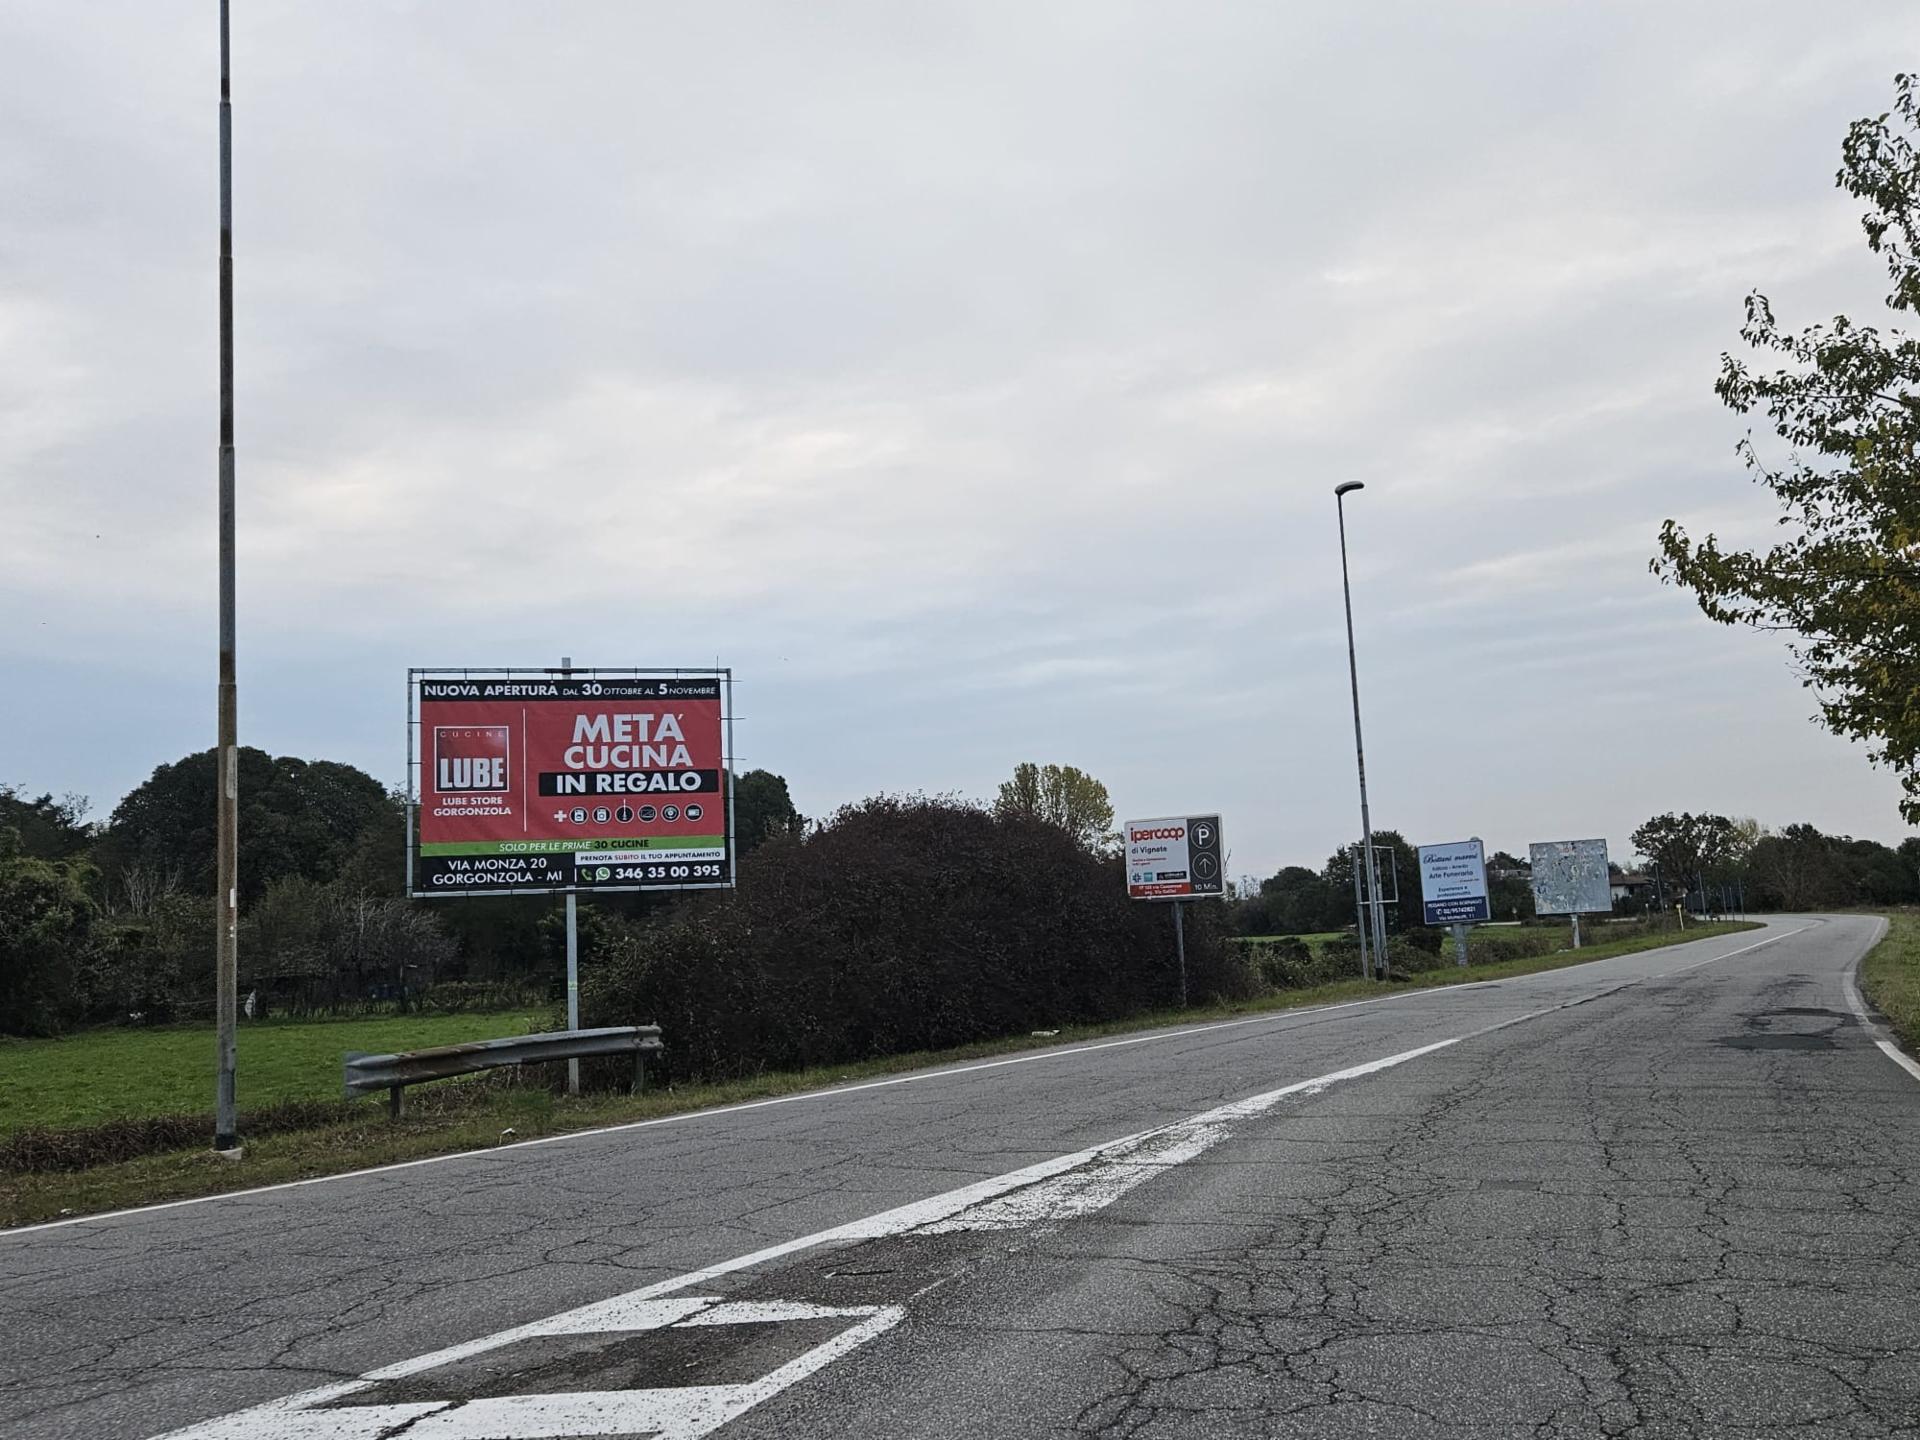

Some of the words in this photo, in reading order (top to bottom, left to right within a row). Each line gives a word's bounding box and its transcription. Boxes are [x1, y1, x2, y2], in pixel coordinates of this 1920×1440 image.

[424, 685, 480, 696] NUOVA
[484, 685, 558, 696] APERTURA
[562, 688, 580, 696] DAL
[582, 683, 602, 696] 30
[603, 687, 643, 696] OTTOBRE
[644, 687, 655, 695] AL
[658, 683, 668, 695] 5
[669, 686, 716, 695] NOVEMBRE
[440, 730, 504, 738] CUCINE
[563, 744, 694, 769] CUCINA
[440, 757, 504, 788] LUBE
[556, 774, 586, 794] IN
[596, 771, 702, 793] REGALO
[442, 797, 468, 806] LUBE
[470, 796, 503, 806] STORE
[433, 807, 512, 816] GORGONZOLA
[1130, 827, 1185, 843] ipercoop
[499, 843, 527, 852] SOLO
[529, 842, 547, 851] PER
[548, 842, 560, 851] LE
[562, 841, 592, 850] PRIME
[594, 840, 608, 849] 30
[611, 839, 650, 849] CUCINE
[1131, 846, 1139, 855] di
[1139, 845, 1168, 855] Vignate
[580, 854, 613, 862] PRENOTA
[640, 853, 648, 861] IL
[664, 851, 721, 860] APPUNTAMENTO
[447, 860, 471, 871] VIA
[474, 859, 527, 871] MONZA
[529, 857, 547, 869] 20
[432, 871, 534, 885] GORGONZOLA
[546, 870, 563, 882] MI
[615, 867, 644, 879] 346
[647, 867, 666, 878] 35
[670, 865, 689, 878] 00
[693, 864, 720, 877] 395
